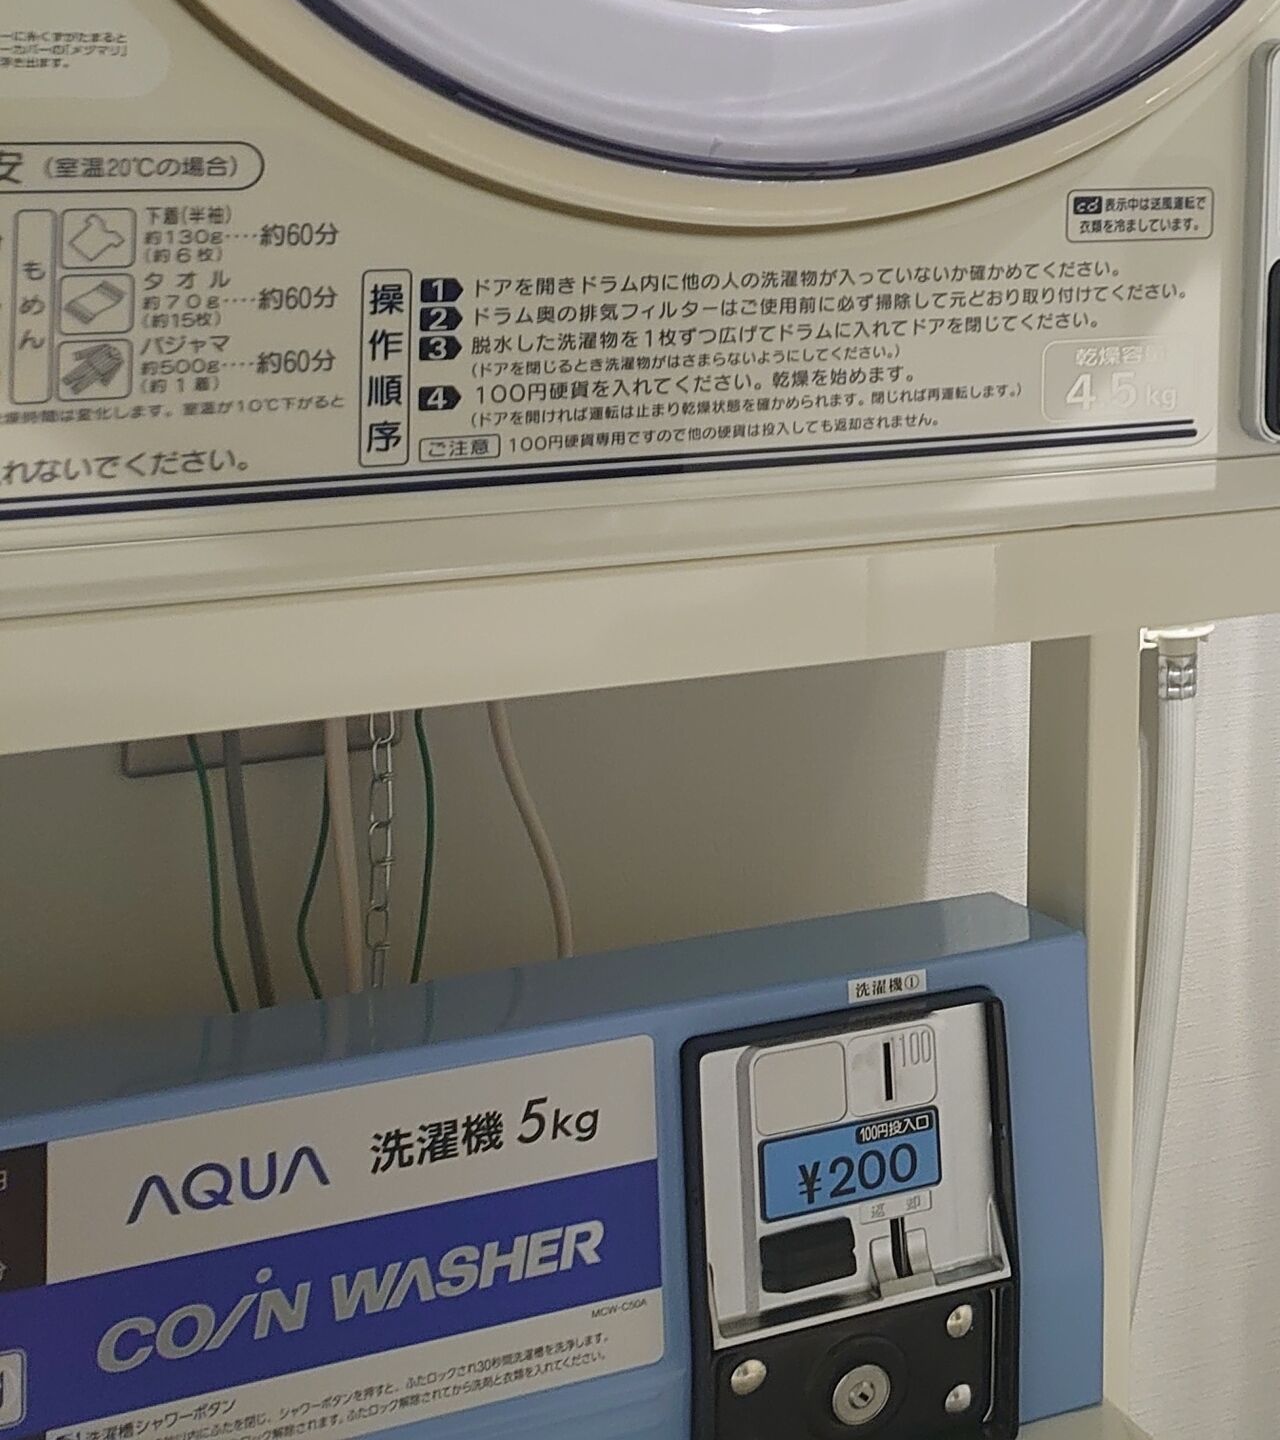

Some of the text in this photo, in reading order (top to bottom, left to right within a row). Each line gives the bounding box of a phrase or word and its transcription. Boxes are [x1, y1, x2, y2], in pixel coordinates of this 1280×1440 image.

[1105, 194, 1207, 213] 表示中は送風運転で
[144, 222, 340, 248] 約130g 約60分
[1079, 216, 1201, 235] 衣類を冷ましています。
[143, 271, 231, 290] タオル
[473, 261, 1121, 298] ドアを開きドラム内に他の人の洗濯物が入っていないか確かめてください。
[18, 260, 47, 351] もめん
[142, 285, 338, 311] 約70g 約60分
[472, 283, 1188, 327] ドラム奥の排気フィルターはご使用前に必ず掃除して元どおり取り付けてください。
[140, 335, 231, 356] パジャマ
[470, 311, 1100, 356] 脱水した洗濯物を1枚ずつ広げてドラムに入れてドアを閉じてください。
[140, 348, 336, 377] 約500g 約60分
[367, 282, 405, 454] 操作順序
[1075, 344, 1168, 367] 乾燥容
[476, 364, 915, 405] 100円硬貨を入れてください。乾燥を始めます。
[0, 395, 345, 425] 燥時間は変化します。室温が10℃下がると
[427, 414, 940, 457] ご注意 100円硬貨専用ですので他の硬貨は投入しても返却されません。
[0, 448, 250, 484] れないでください。
[854, 973, 920, 998] 洗濯機①
[369, 1096, 601, 1176] 洗濯機 5kg
[858, 1115, 930, 1143] 100円投入口
[125, 1144, 332, 1227] AQUA
[797, 1142, 918, 1205] ¥200
[330, 1219, 605, 1323] WASHER
